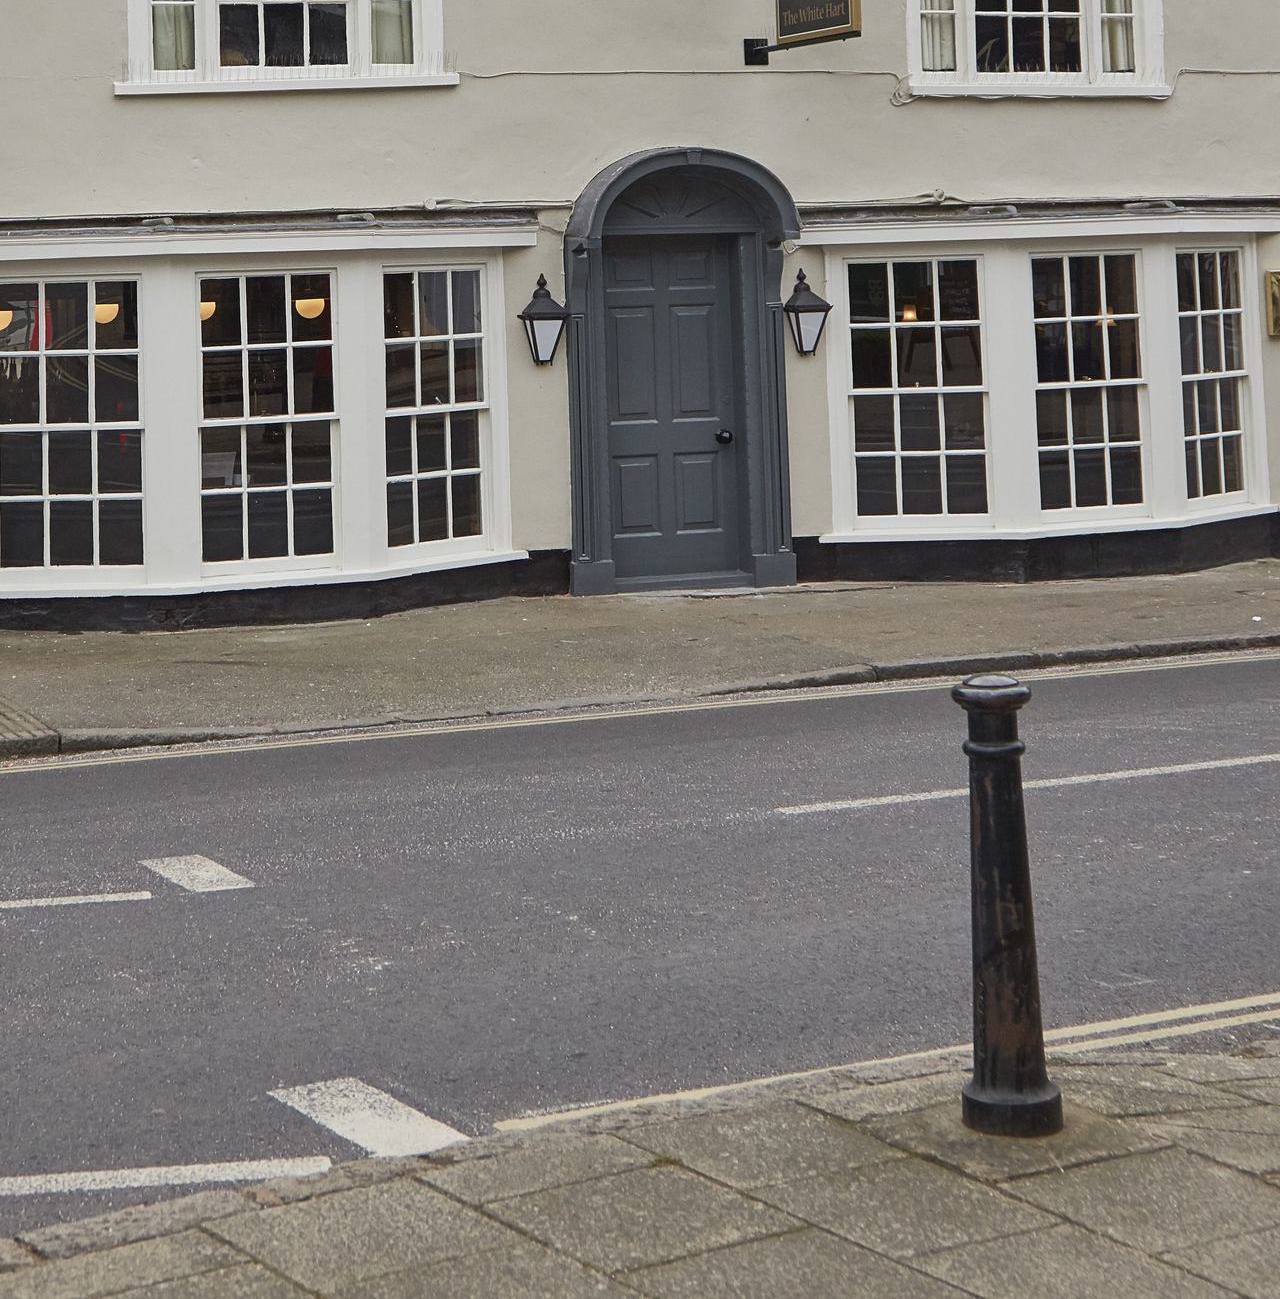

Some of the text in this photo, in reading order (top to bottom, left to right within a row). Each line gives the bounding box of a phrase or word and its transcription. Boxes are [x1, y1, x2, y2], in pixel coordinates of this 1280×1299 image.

[783, 2, 846, 26] The White Hart
